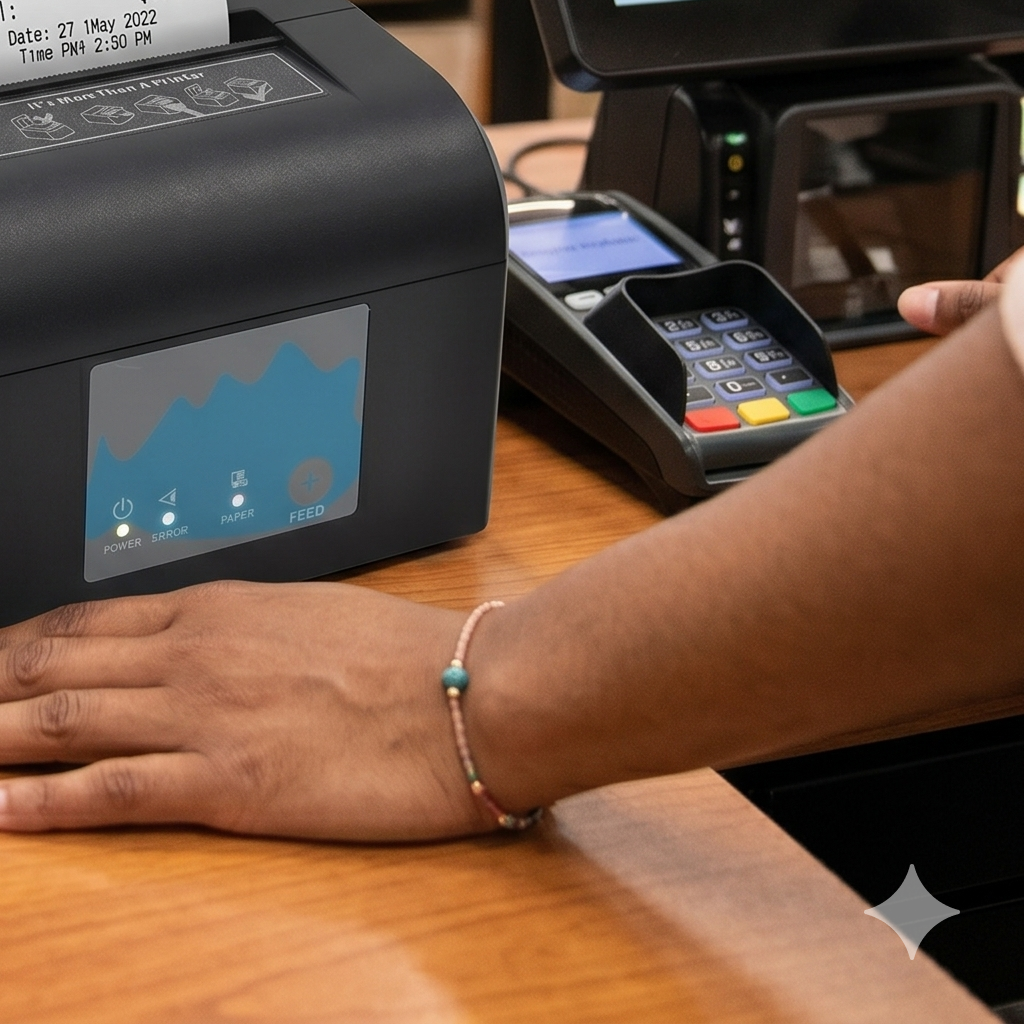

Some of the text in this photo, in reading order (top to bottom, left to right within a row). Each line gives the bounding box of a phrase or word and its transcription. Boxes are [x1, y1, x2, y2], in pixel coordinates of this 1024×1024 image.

[8, 9, 158, 46] Date: 27 1May 2022
[135, 30, 152, 47] PM
[56, 92, 97, 105] More
[95, 85, 137, 97] Than
[139, 82, 152, 90] A
[726, 380, 742, 392] 0
[220, 508, 255, 525] PAPER
[289, 504, 325, 524] FEED
[103, 537, 142, 555] POWER
